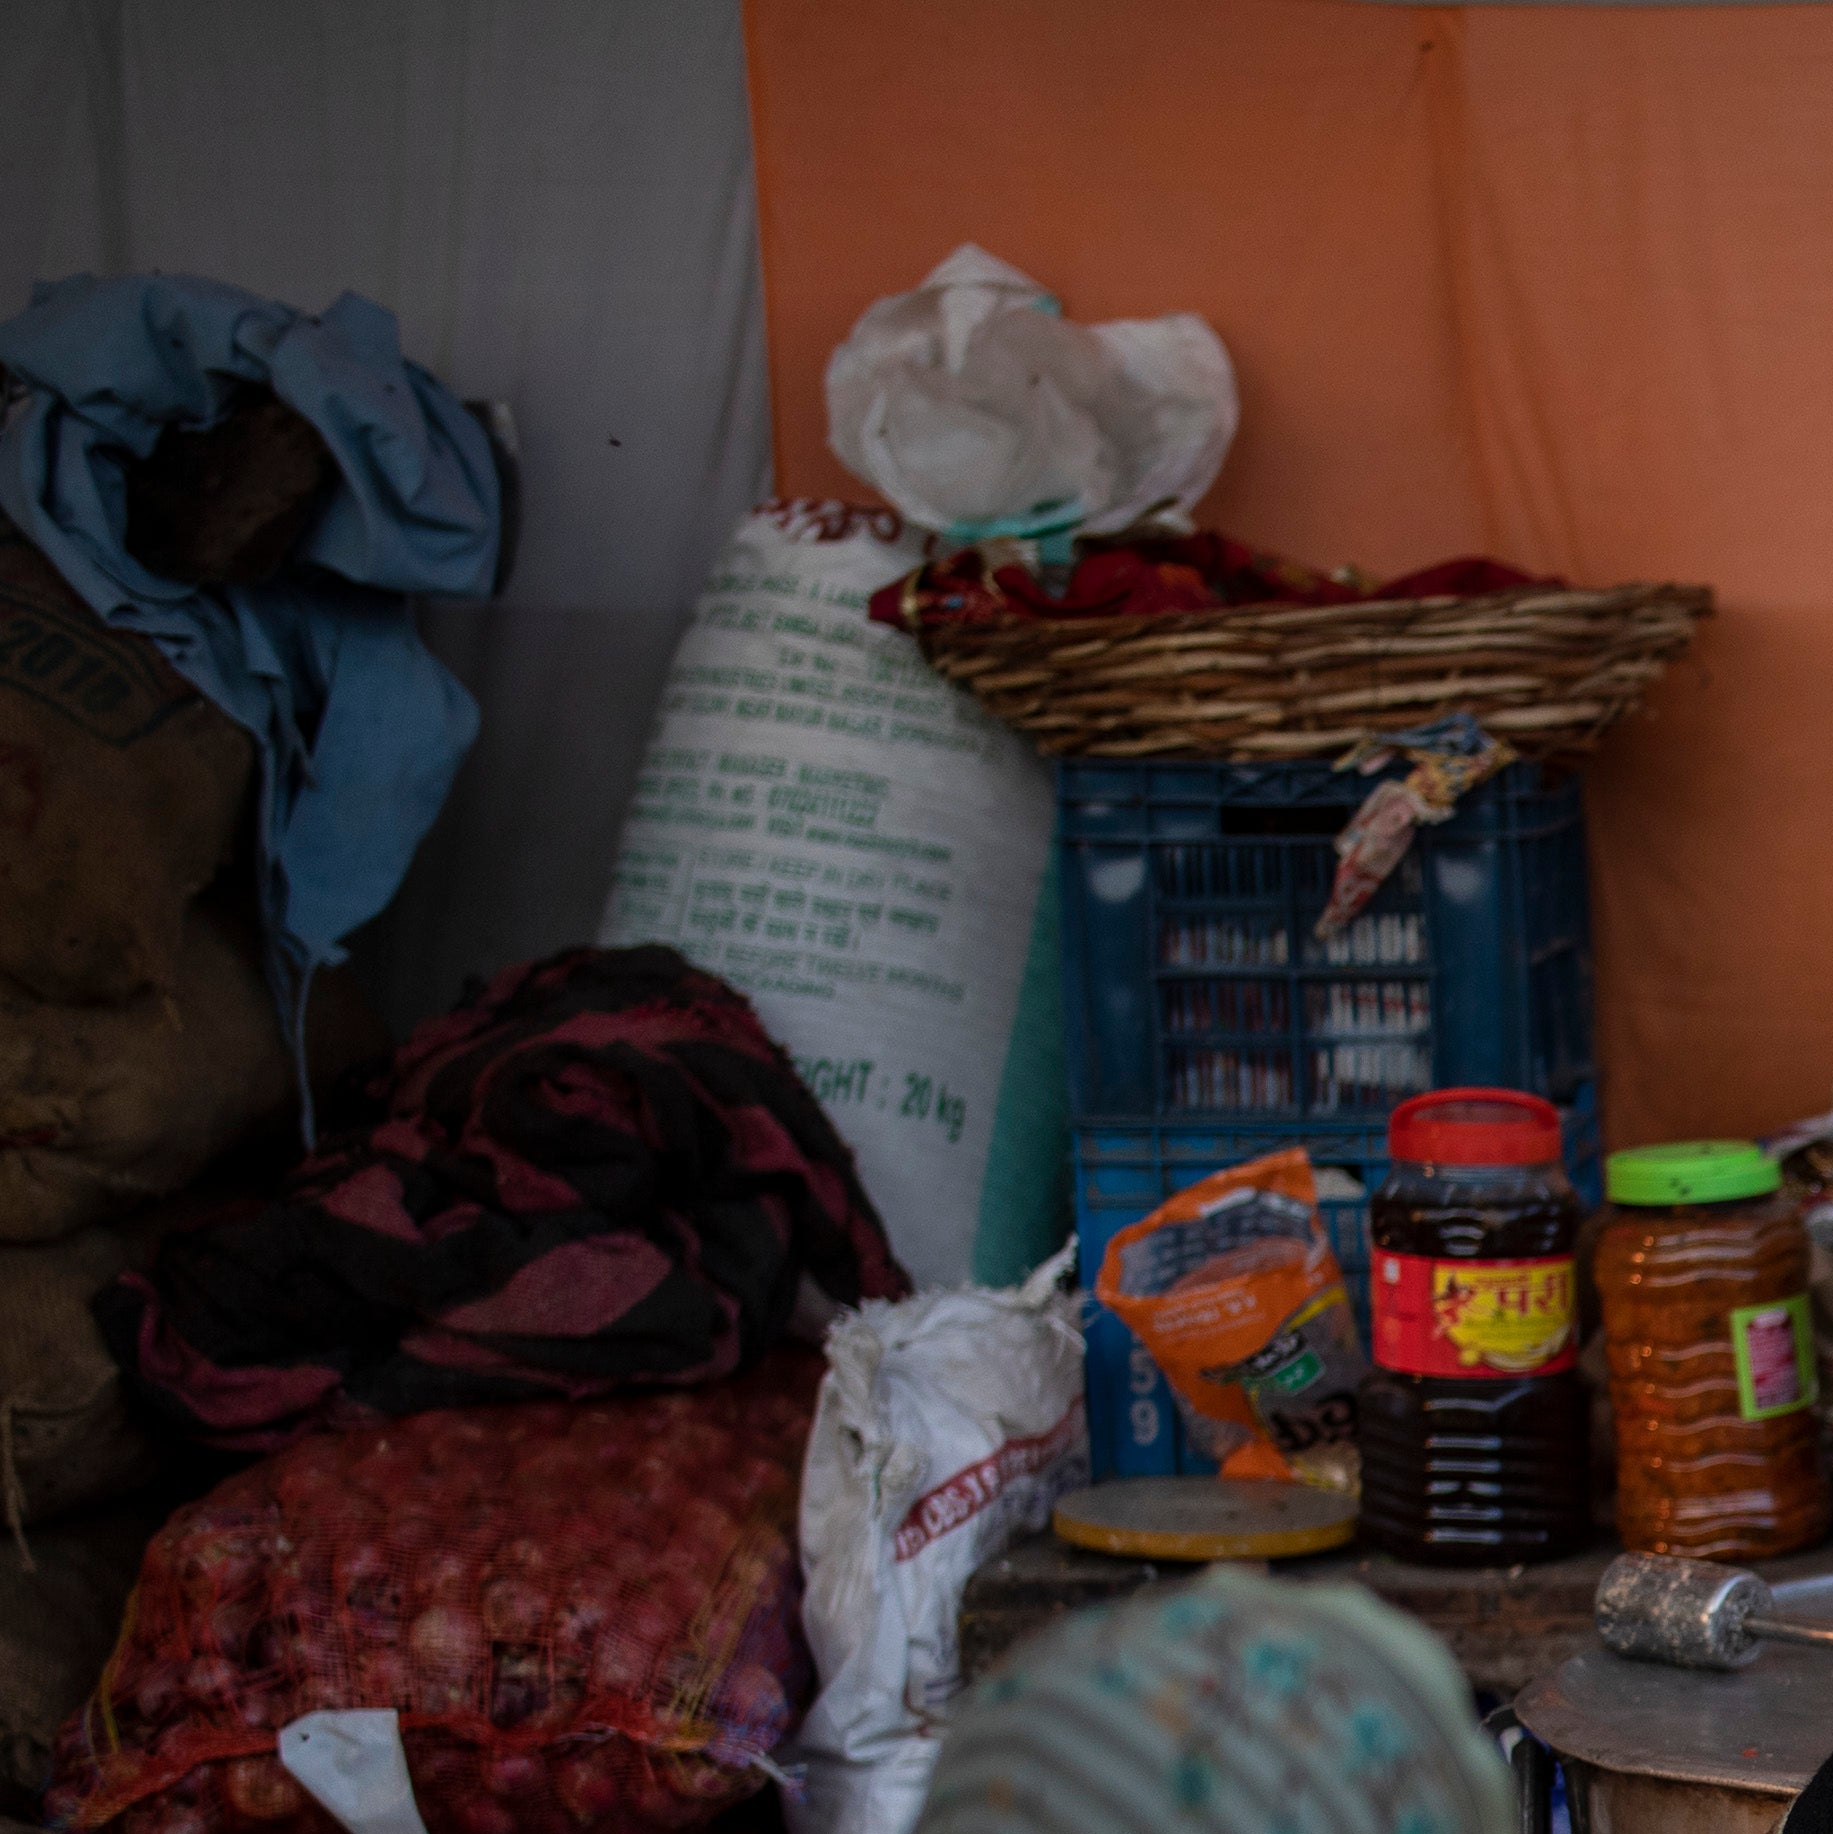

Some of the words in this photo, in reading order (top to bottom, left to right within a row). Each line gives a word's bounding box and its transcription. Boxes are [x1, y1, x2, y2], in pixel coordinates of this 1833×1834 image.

[793, 1055, 873, 1104] IGHT
[901, 1071, 932, 1120] 20
[936, 1084, 966, 1145] kg
